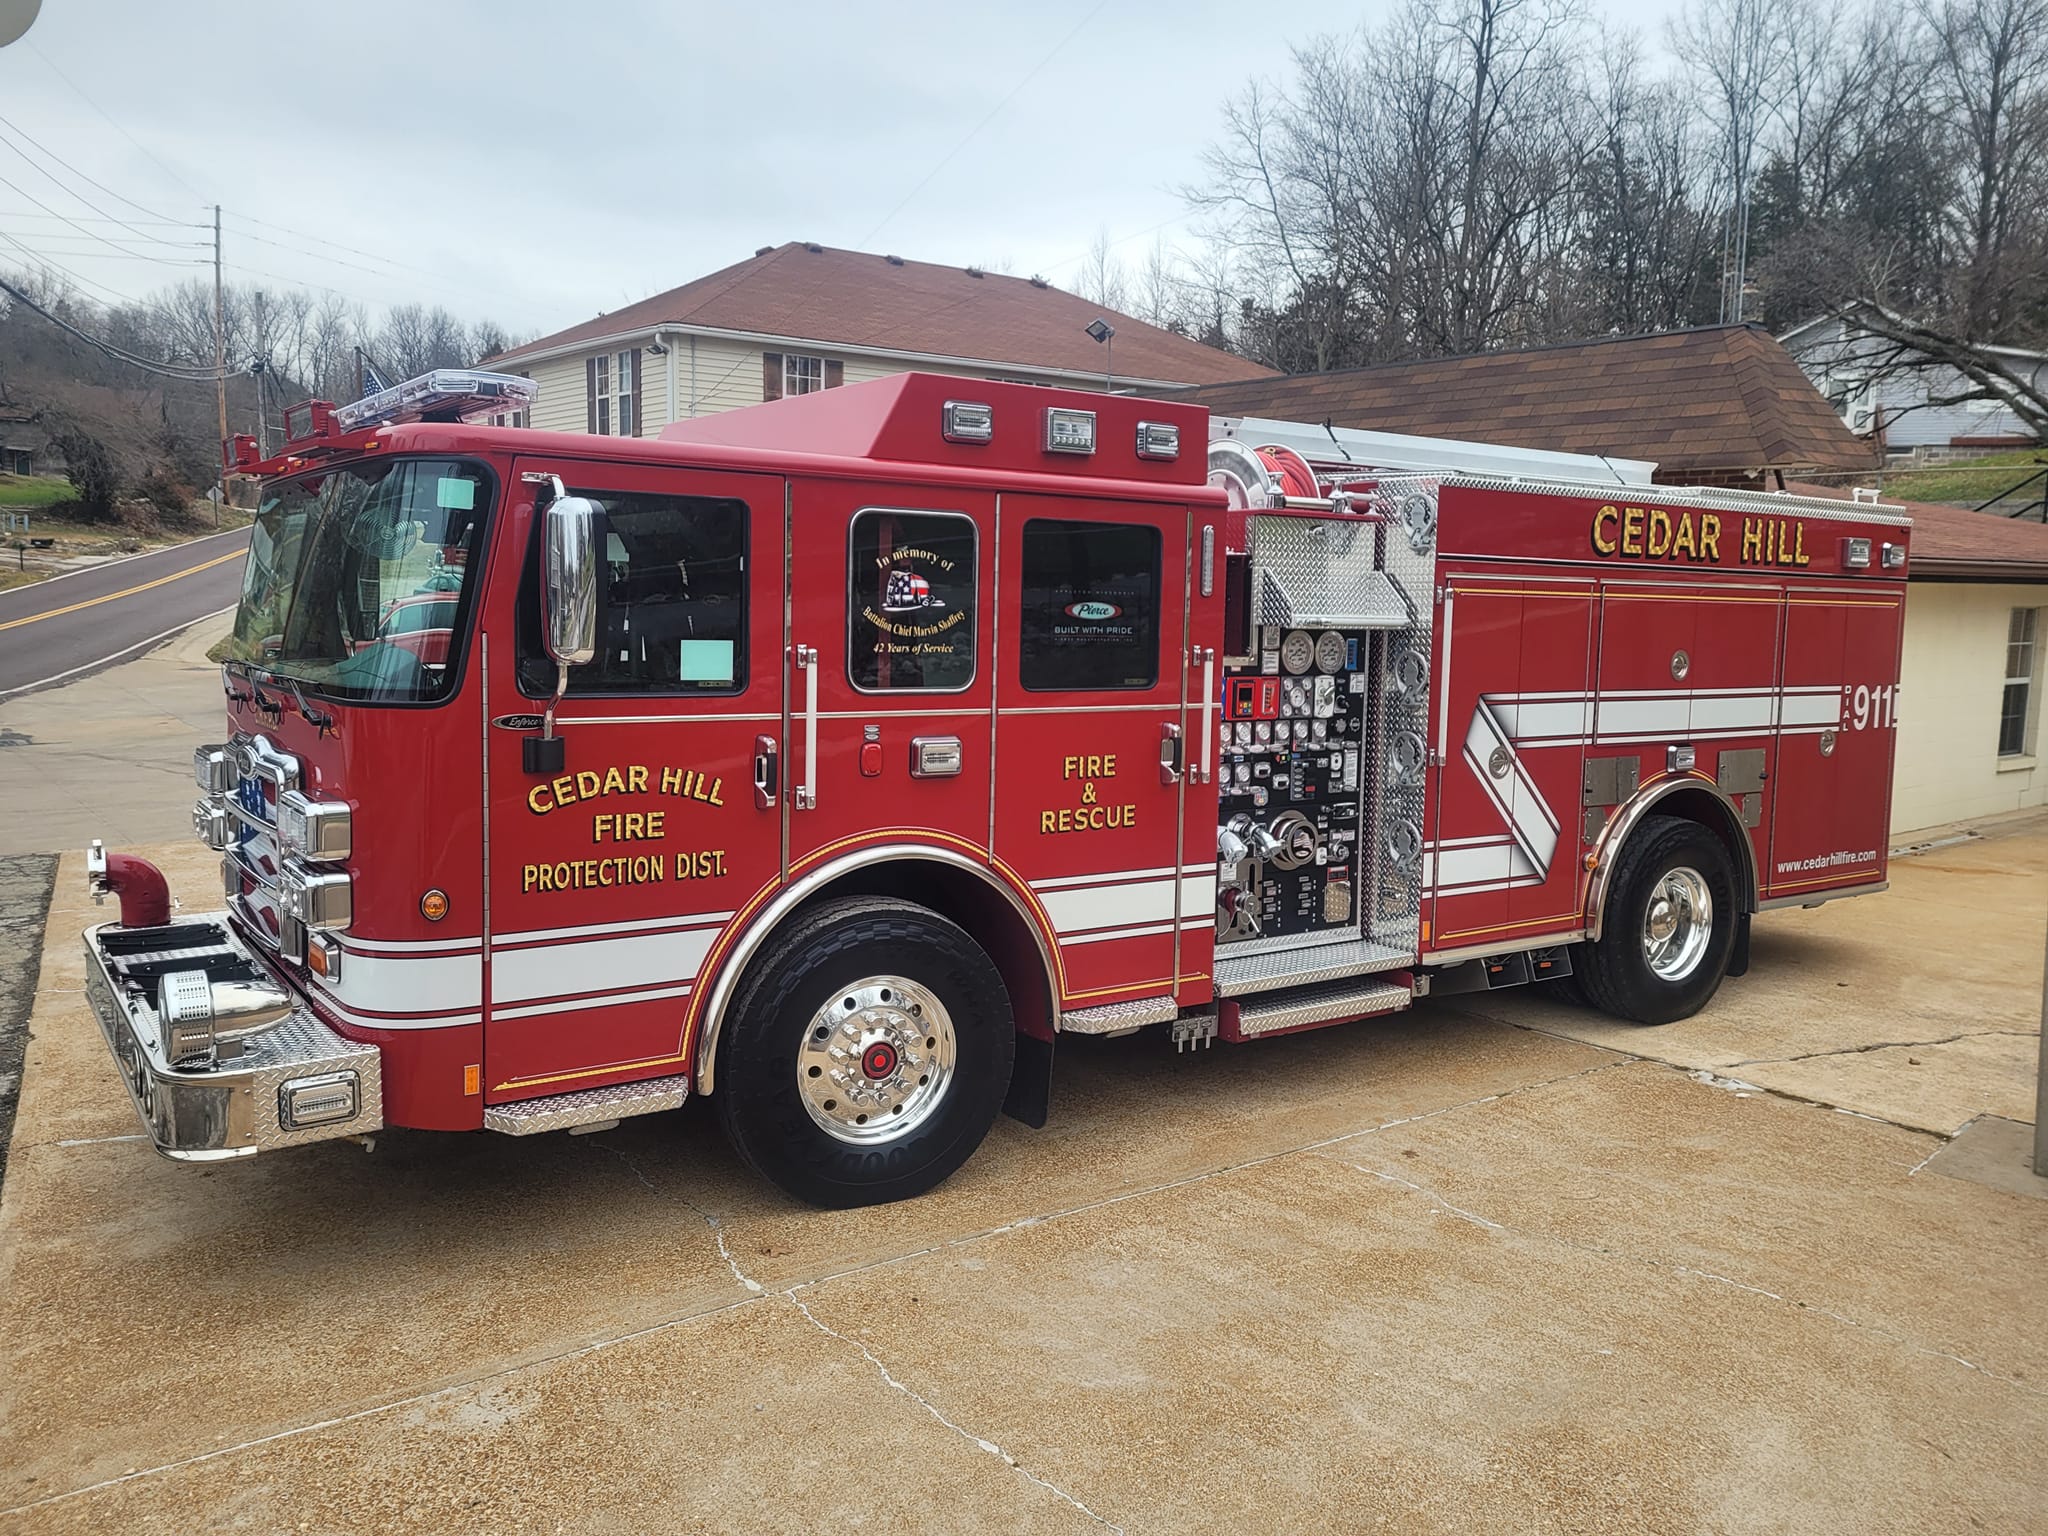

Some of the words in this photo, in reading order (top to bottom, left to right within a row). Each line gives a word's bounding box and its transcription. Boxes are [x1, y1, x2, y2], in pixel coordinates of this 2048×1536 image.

[1591, 505, 1721, 562] CEDAR
[1740, 517, 1810, 568] HILL
[875, 557, 890, 569] In
[892, 548, 939, 565] memory
[941, 558, 955, 571] of
[863, 605, 892, 632] Battalion
[893, 623, 913, 636] Chief
[913, 624, 938, 637] Marvin
[1078, 604, 1110, 616] Pierce
[1054, 626, 1080, 634] BUILT
[873, 643, 884, 653] 42
[887, 643, 910, 653] Years
[912, 643, 922, 655] of
[922, 643, 954, 653] Service
[1842, 685, 1852, 731] DIAL
[1853, 684, 1893, 730] 911
[1064, 754, 1116, 779] FIRE
[528, 765, 649, 815] CEDAR
[660, 766, 724, 807] HILL
[1081, 782, 1097, 804] &
[593, 811, 665, 843] FIRE
[1041, 804, 1136, 834] RESCUE
[522, 854, 664, 893] PROTECTION
[675, 850, 728, 880] DIST.
[1777, 850, 1876, 873] www.cedarhillfire.com
